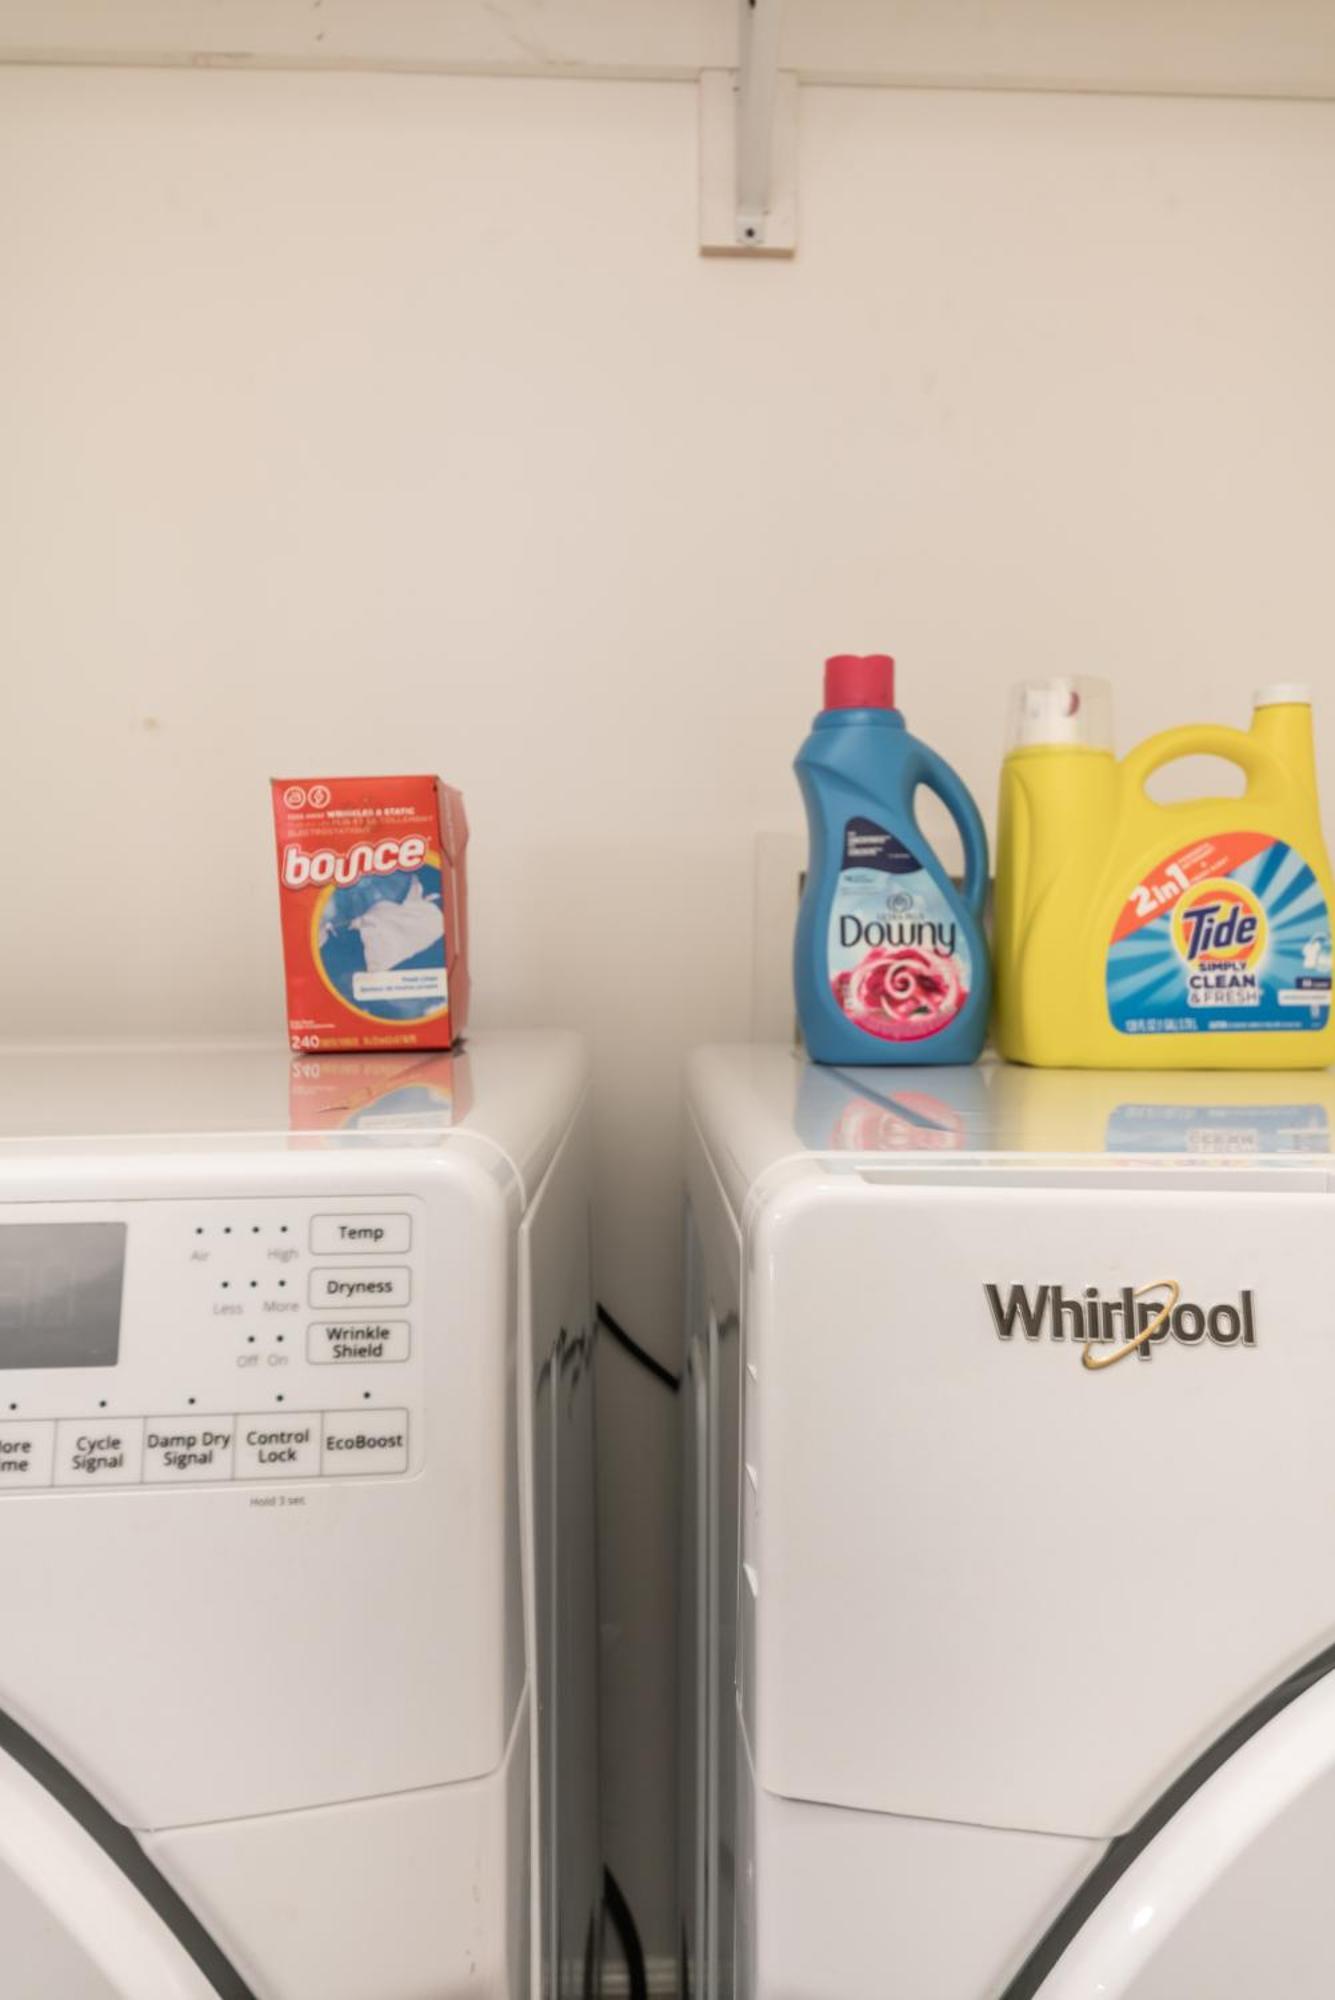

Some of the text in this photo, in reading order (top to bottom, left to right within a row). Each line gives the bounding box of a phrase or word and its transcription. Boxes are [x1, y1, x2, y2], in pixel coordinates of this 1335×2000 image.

[283, 836, 426, 887] bounce
[1129, 862, 1191, 918] 2in1
[840, 915, 956, 957] Downy
[1183, 904, 1257, 960] Tide
[1198, 963, 1247, 973] SIMPLY
[1189, 975, 1256, 988] CLEAN
[291, 1035, 319, 1049] 240
[338, 1226, 384, 1241] Temp
[190, 1248, 299, 1262] Air High
[327, 1280, 393, 1297] Dryness
[213, 1301, 299, 1315] Less More
[983, 1280, 1257, 1362] Whirlpool
[326, 1326, 390, 1341] Wrinkle
[333, 1343, 383, 1358] Shield
[237, 1353, 288, 1367] Off On
[76, 1436, 122, 1454] Cycle
[147, 1432, 231, 1450] Damp Dry
[246, 1429, 310, 1446] Control
[325, 1434, 403, 1450] EcoBoost
[0, 1441, 31, 1454] ore
[258, 1447, 297, 1463] Lock
[72, 1453, 124, 1473] Signal
[163, 1450, 213, 1470] Signal
